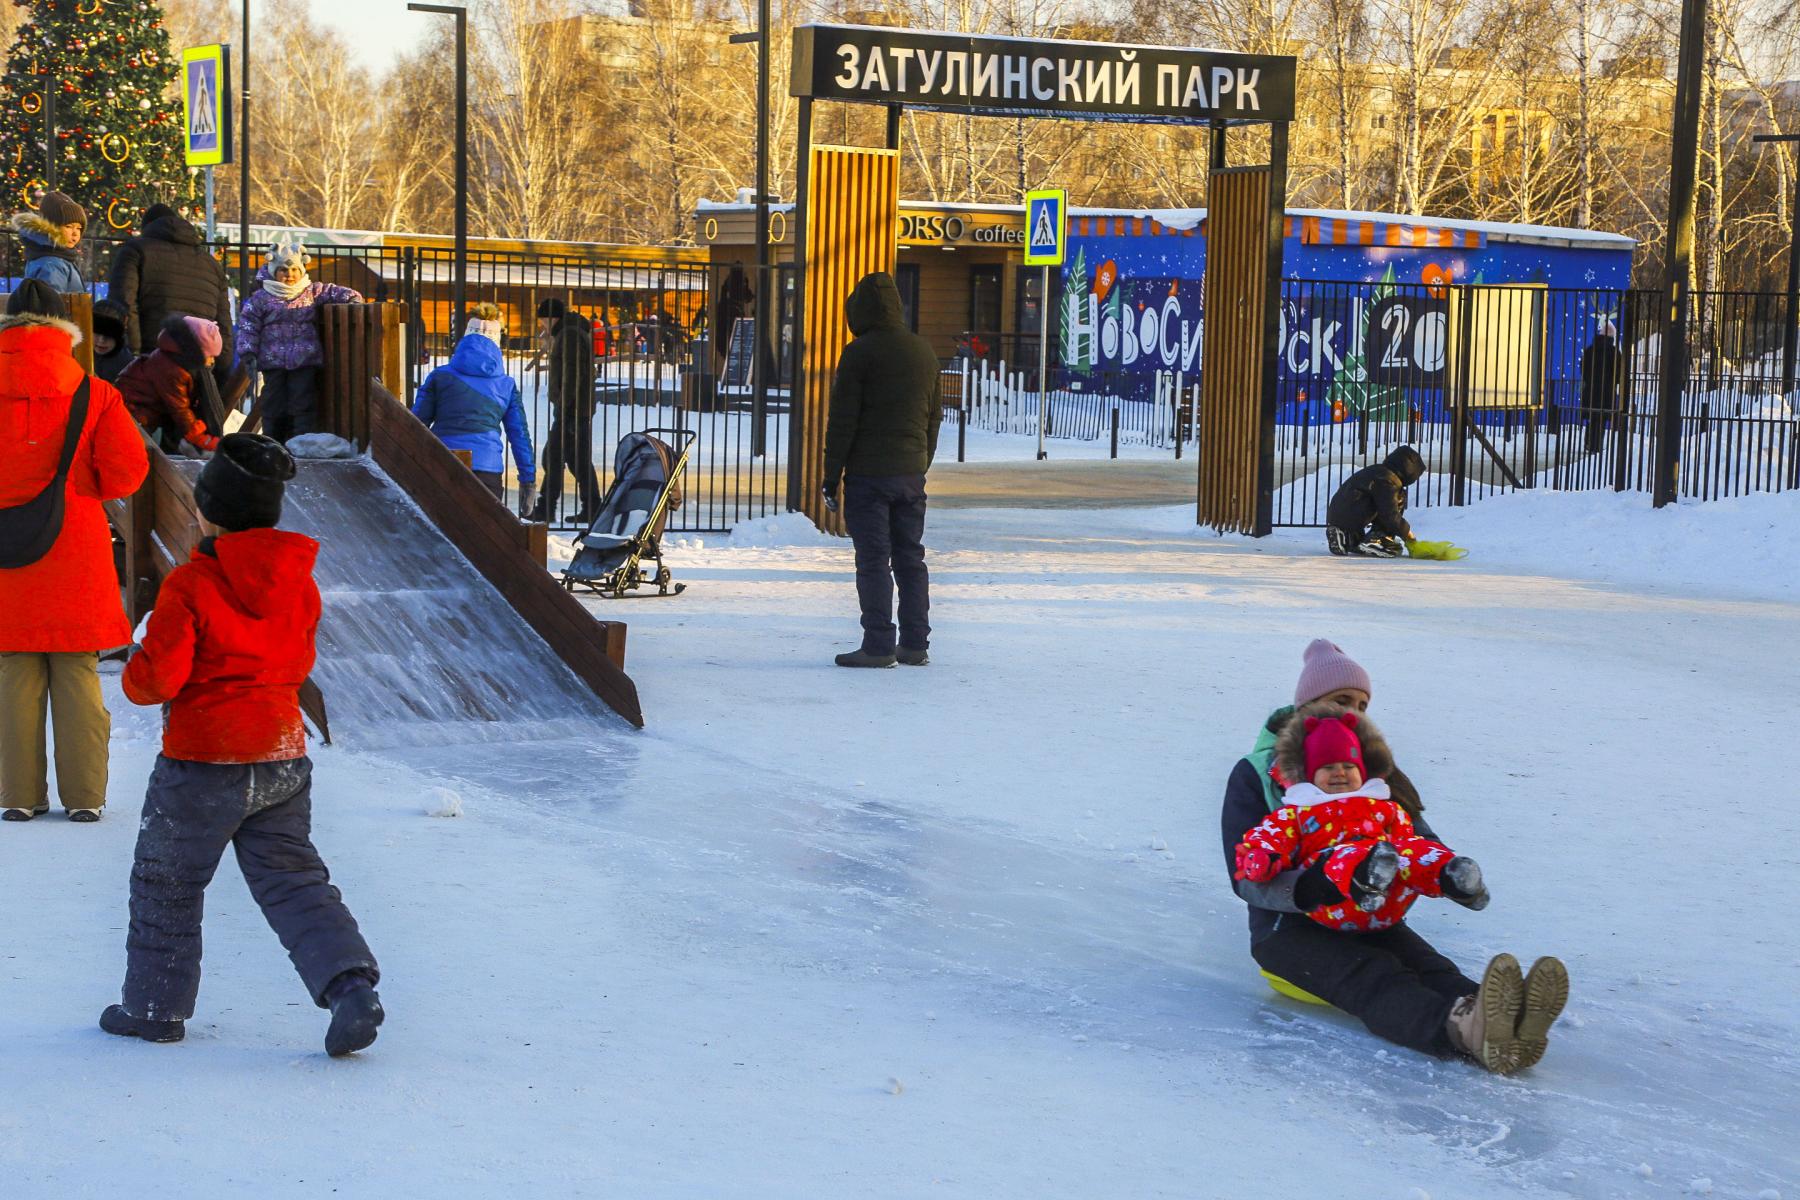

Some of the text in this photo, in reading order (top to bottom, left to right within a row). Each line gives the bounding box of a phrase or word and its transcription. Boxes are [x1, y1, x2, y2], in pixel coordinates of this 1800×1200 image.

[834, 43, 1261, 111] ЗАТУЛИНСКИЙ ПАРК
[974, 224, 1025, 243] coffee
